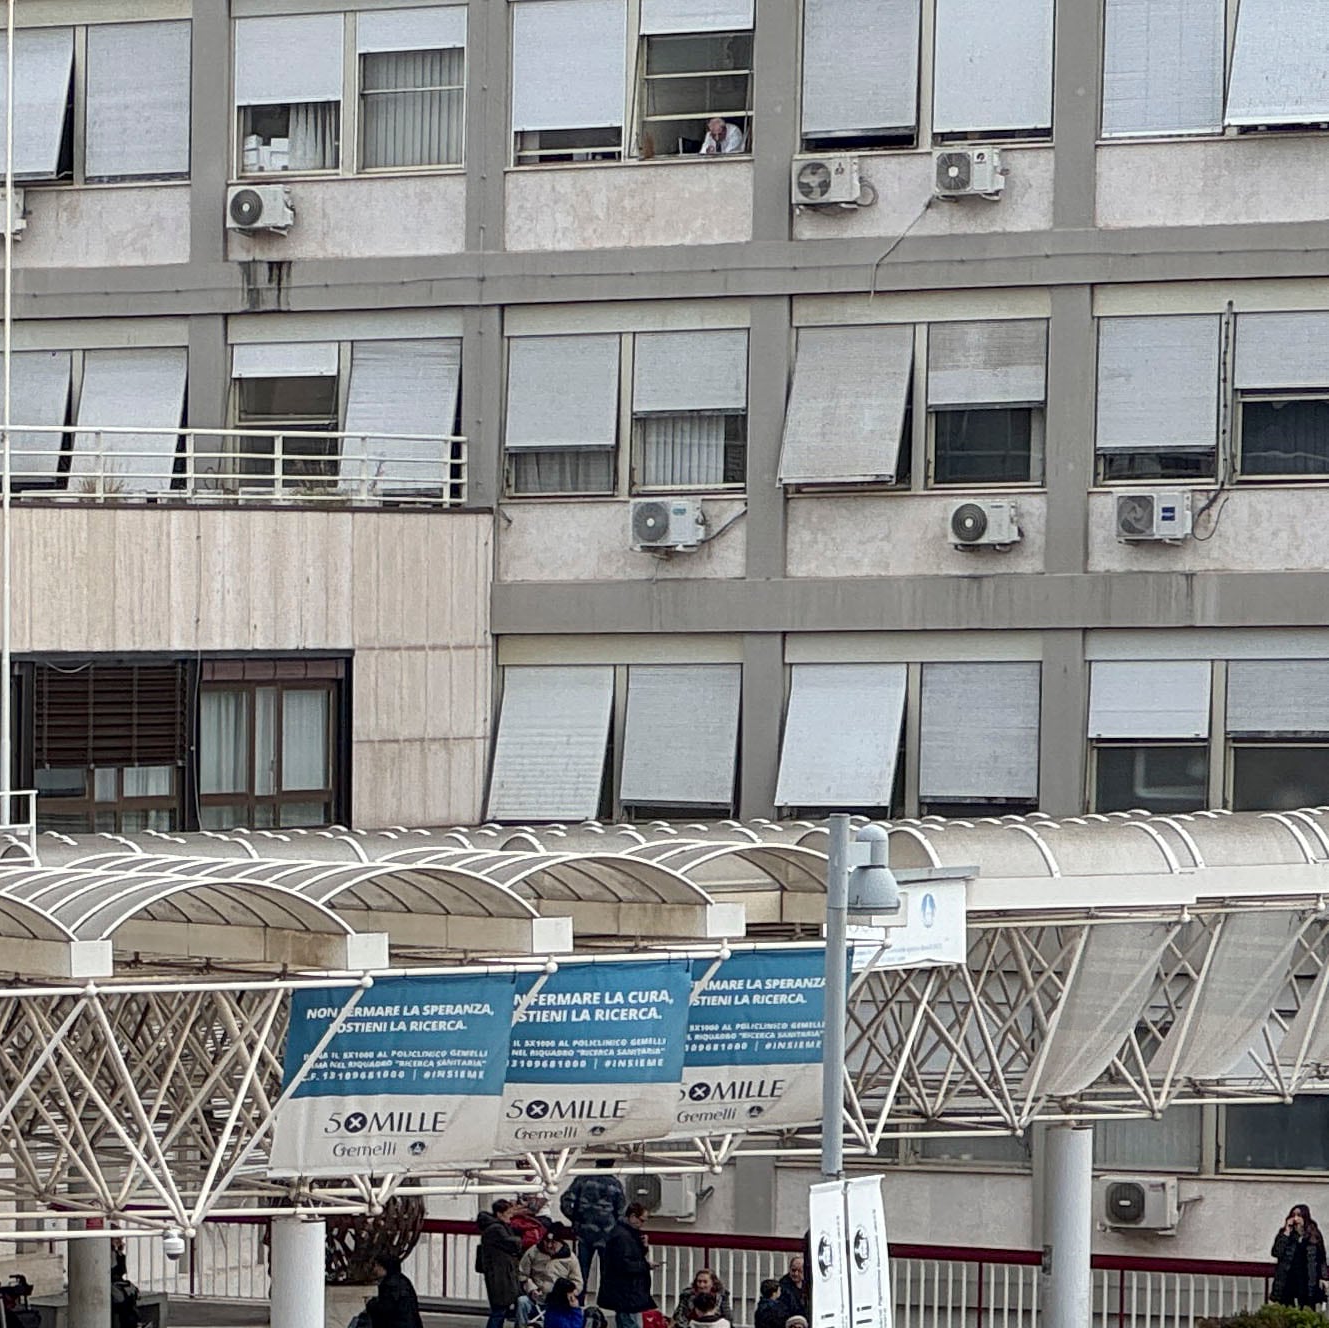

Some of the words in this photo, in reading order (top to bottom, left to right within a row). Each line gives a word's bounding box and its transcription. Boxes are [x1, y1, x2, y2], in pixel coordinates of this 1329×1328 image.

[746, 978, 763, 990] LA
[604, 991, 625, 1005] LA
[627, 989, 675, 1005] CURA,
[734, 993, 750, 1006] LA
[752, 992, 808, 1005] RICERCA.
[306, 1007, 338, 1019] NON
[342, 1005, 401, 1018] ERMARE
[403, 1005, 420, 1016] LA
[422, 1003, 494, 1016] SPERANZA,
[570, 1008, 591, 1022] LA
[594, 1007, 663, 1021] RICERCA.
[330, 1021, 388, 1033] OSTIENI
[389, 1020, 407, 1032] LA
[409, 1019, 468, 1032] RICERCA.
[558, 1039, 570, 1047] AL
[572, 1038, 628, 1047] POLICLINICO
[629, 1037, 667, 1046] GEMELLI
[676, 1107, 737, 1124] Gemelli
[514, 1126, 578, 1140] Gemelli
[332, 1141, 398, 1157] Gemelli
